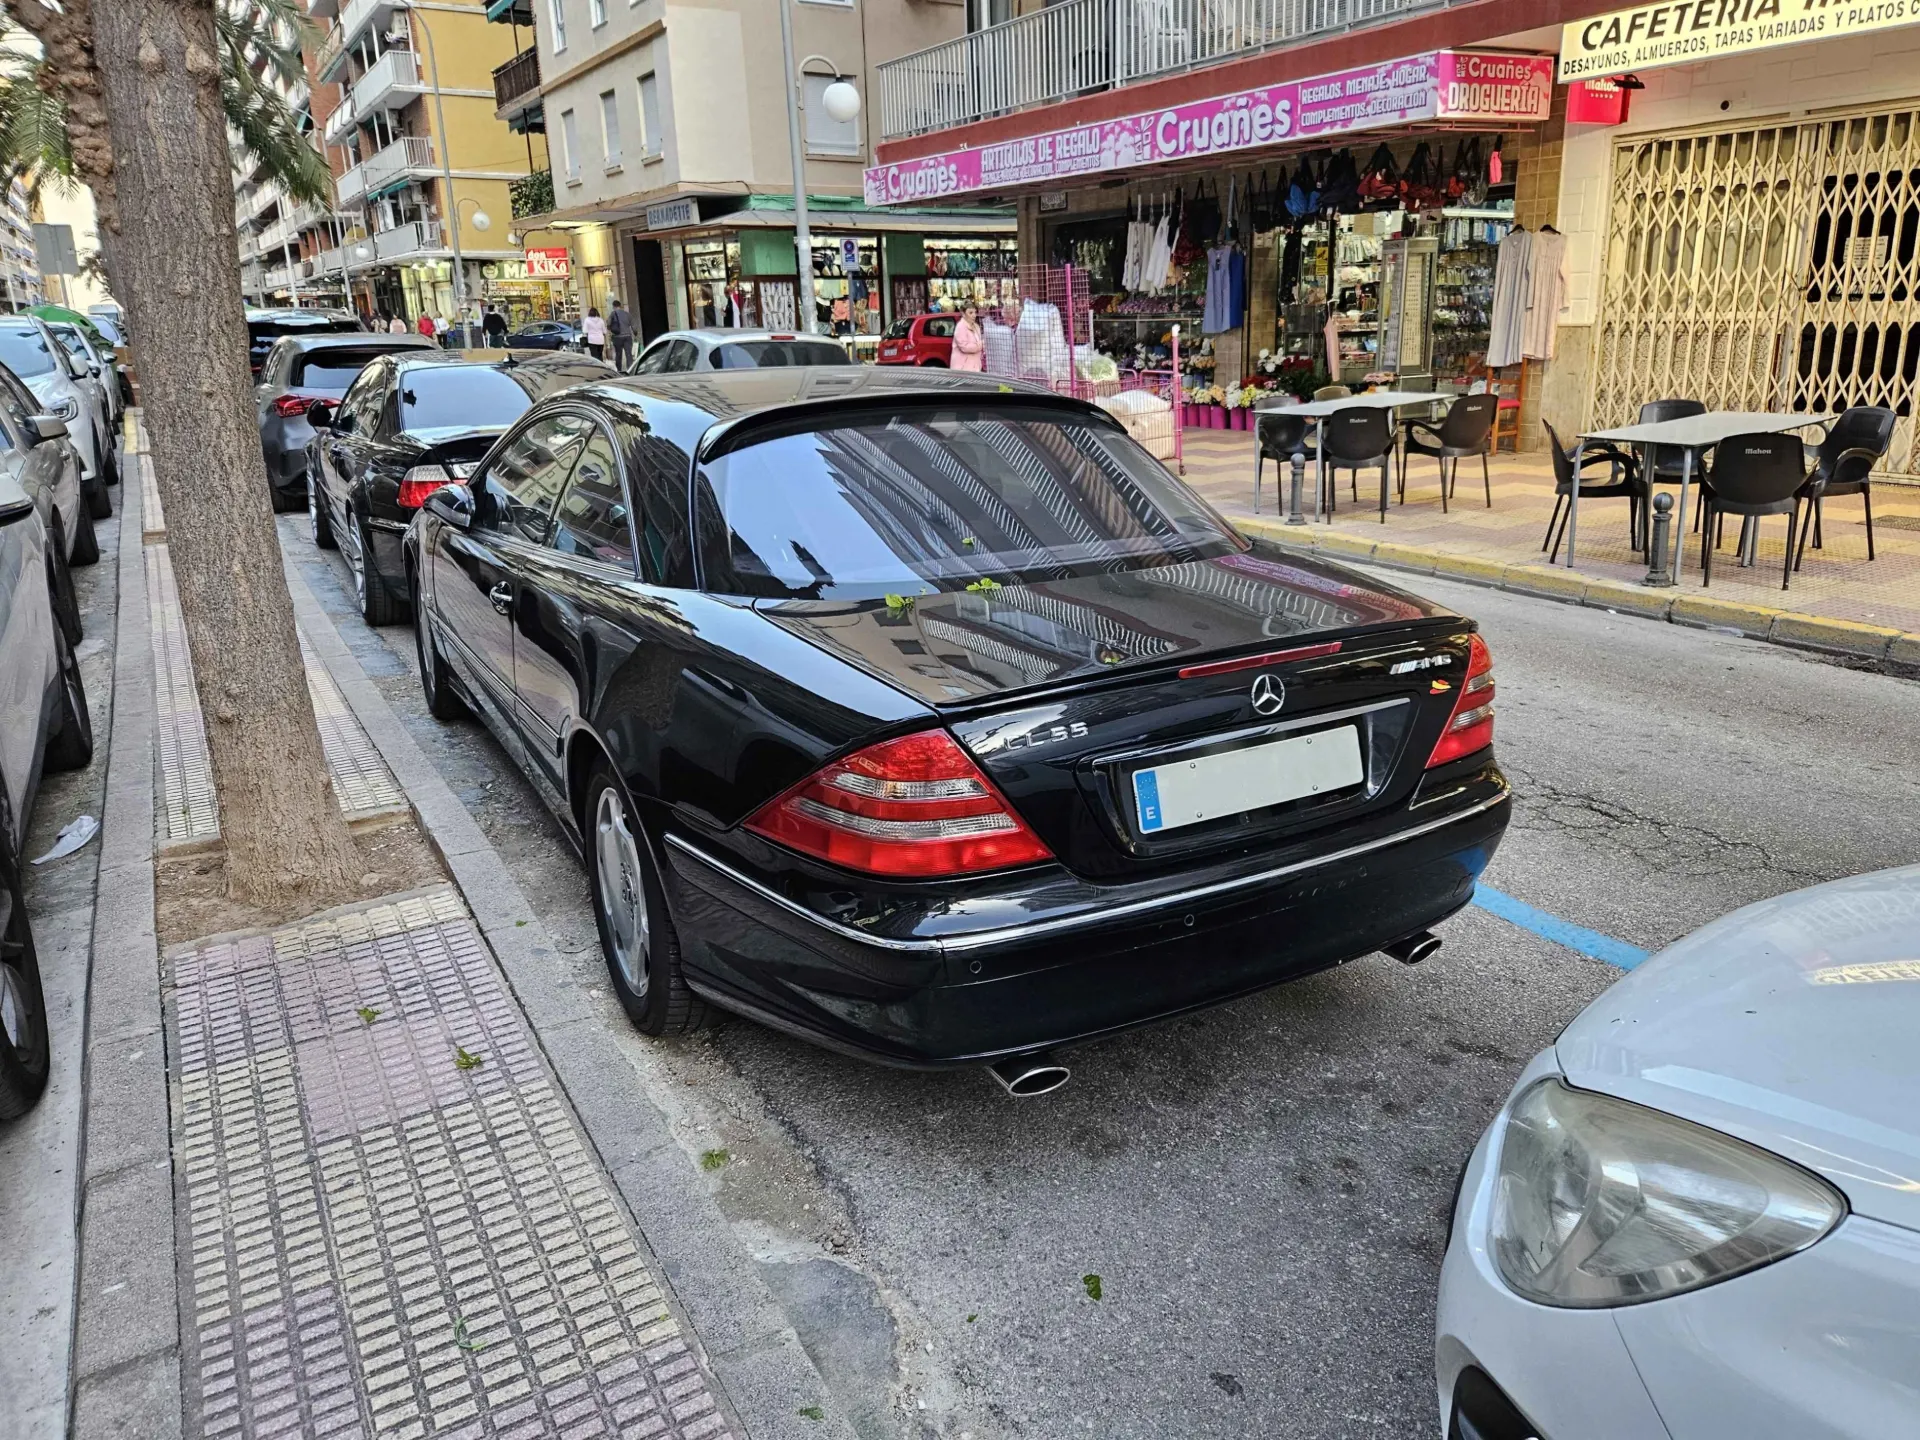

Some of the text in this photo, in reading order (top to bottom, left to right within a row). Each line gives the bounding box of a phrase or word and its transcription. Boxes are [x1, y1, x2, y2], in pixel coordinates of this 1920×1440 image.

[1563, 50, 1631, 75] DESAYUNOS,
[1634, 36, 1710, 63] ALMUERZOS,
[1715, 27, 1754, 48] TAPAS
[1758, 15, 1825, 41] VARIADAS
[1835, 11, 1845, 28] Y
[1848, 2, 1905, 26] PLATOS
[1582, 0, 1780, 51] CAFETERIA
[1468, 57, 1532, 80] Cruañes
[1448, 80, 1540, 114] DROGUERÍA
[1156, 97, 1292, 155] Cruañes
[1039, 137, 1054, 162] DE
[1056, 128, 1100, 160] REGALO
[888, 160, 957, 197] Cruañes
[1145, 806, 1156, 820] E
